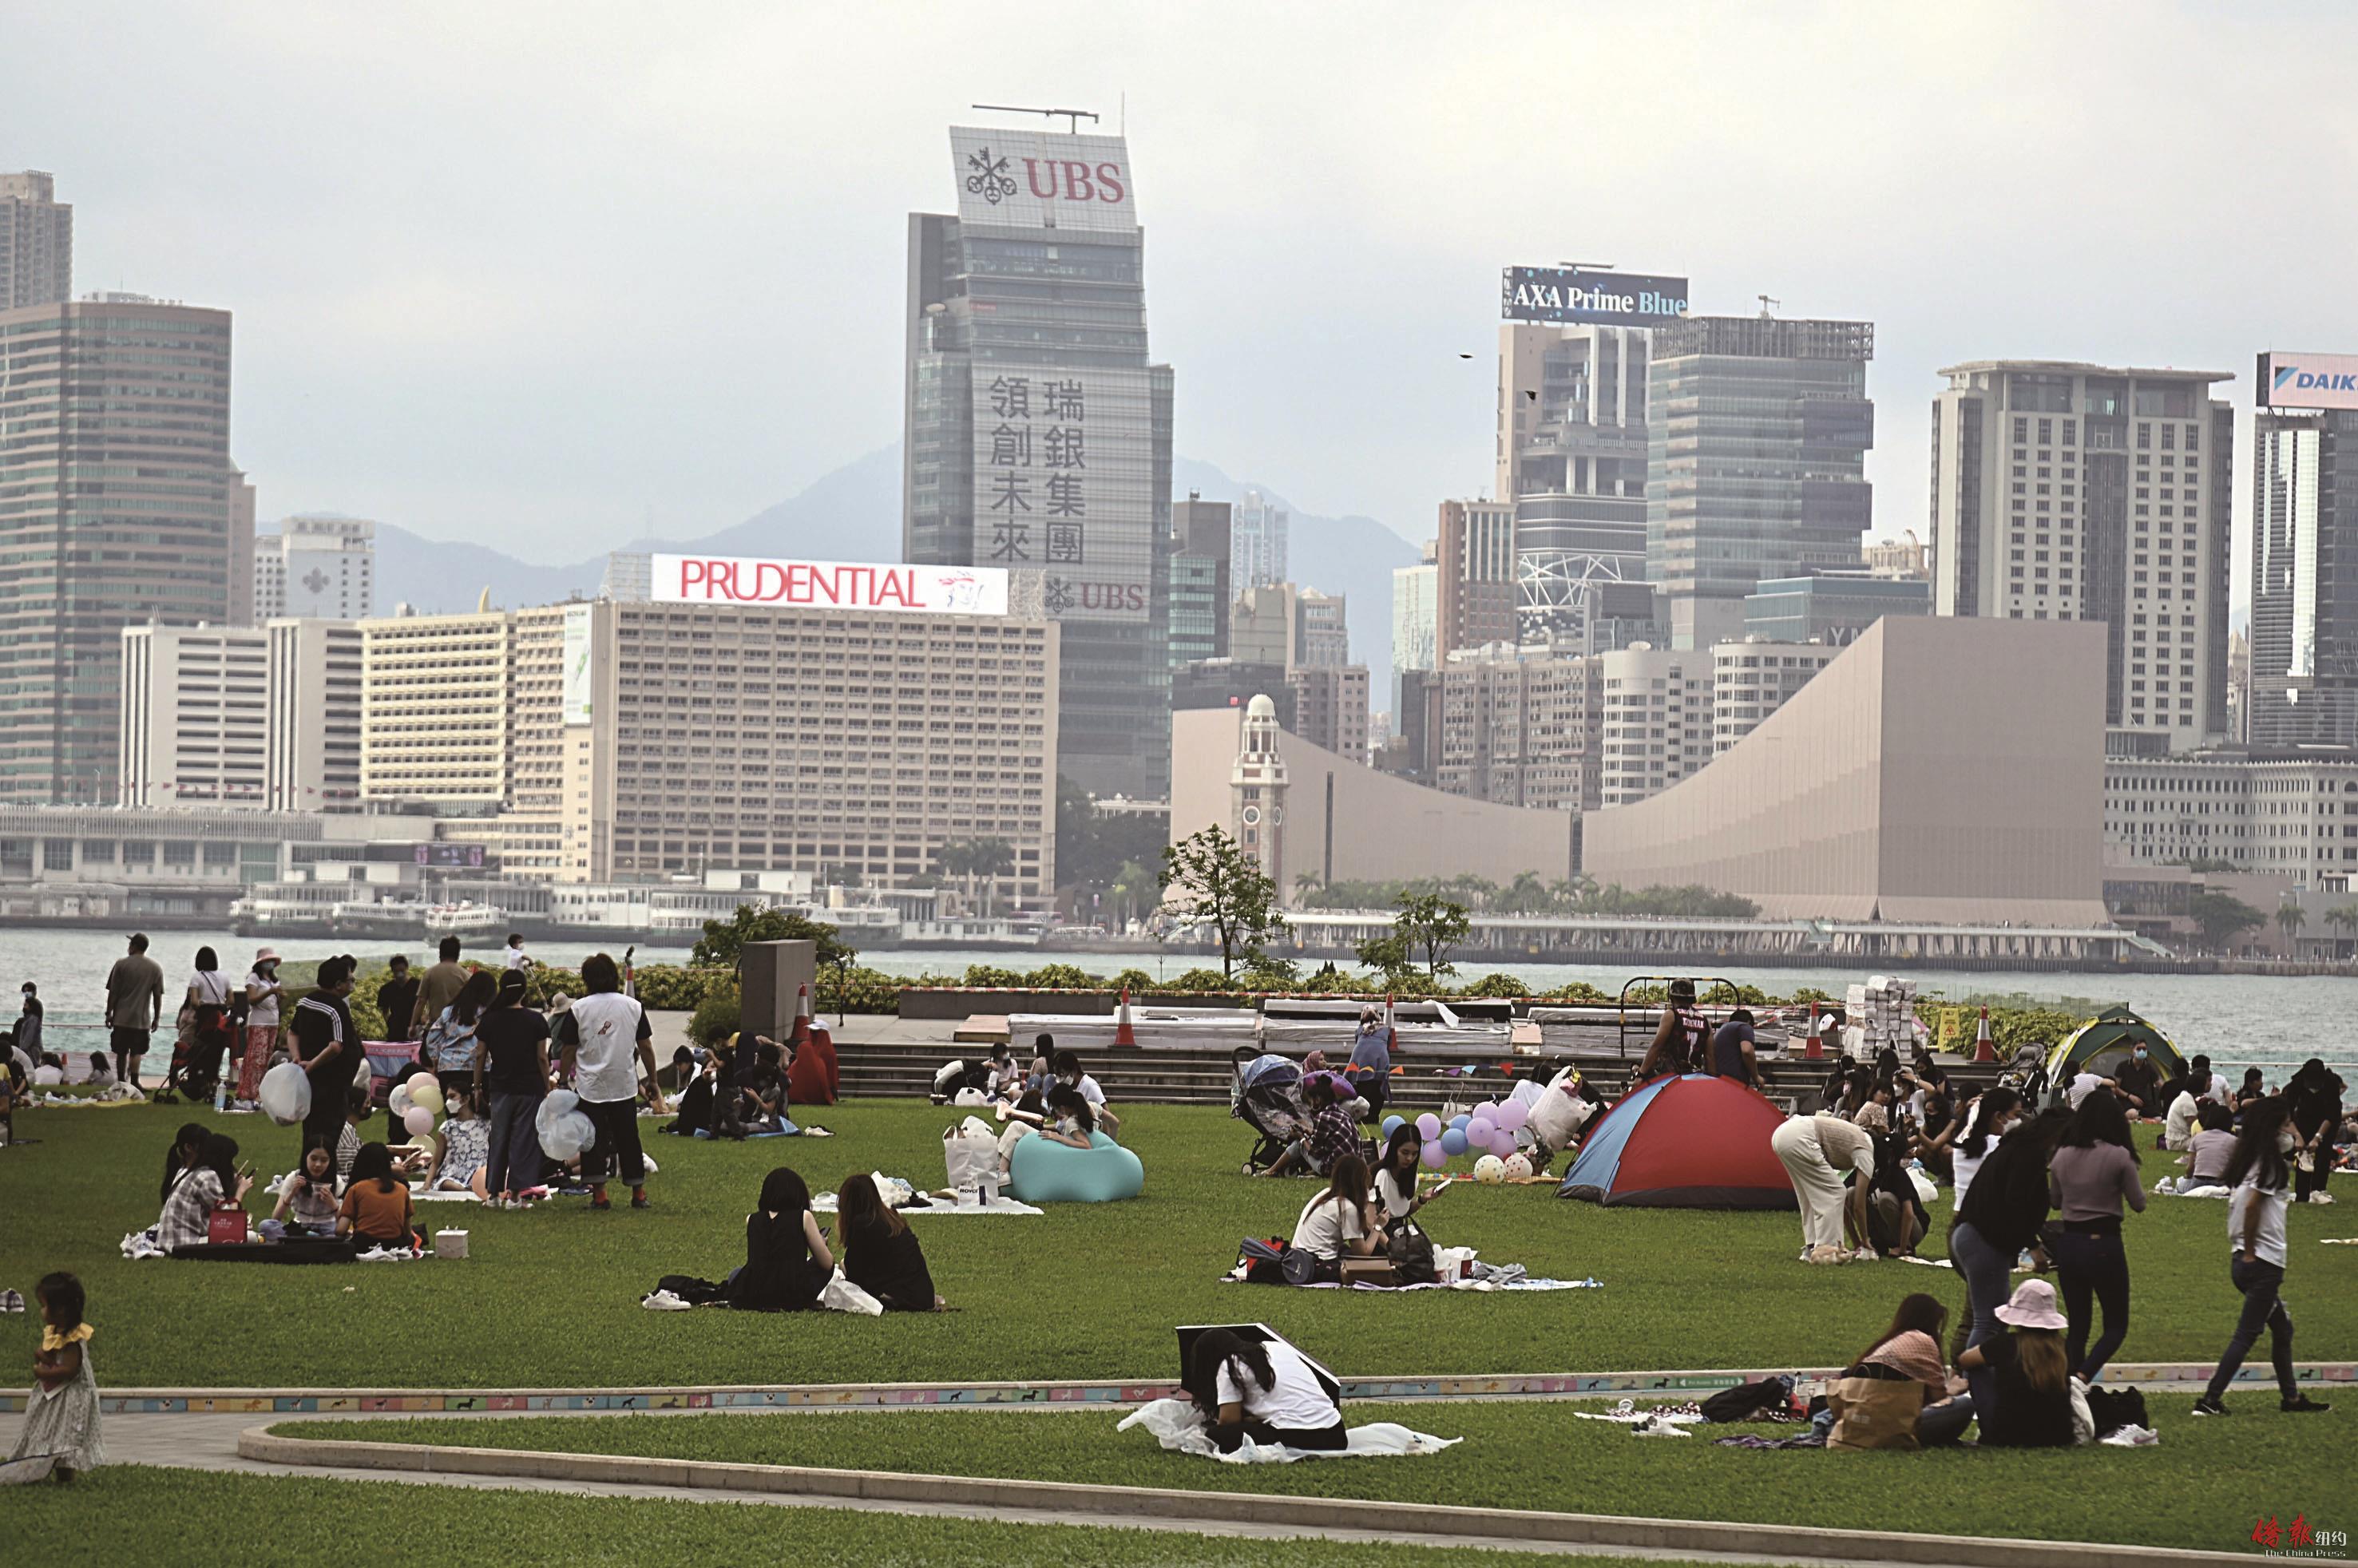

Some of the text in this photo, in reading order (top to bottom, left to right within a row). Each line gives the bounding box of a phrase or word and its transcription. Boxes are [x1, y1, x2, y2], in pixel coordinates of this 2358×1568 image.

[1022, 158, 1124, 204] UBS
[1514, 283, 1687, 318] AXA Prime Blue
[2297, 372, 2358, 390] DAIK
[990, 375, 1032, 562] 領創未來
[1043, 378, 1085, 565] 瑞銀集團
[681, 560, 926, 608] PRUDENTIAL
[1080, 582, 1144, 611] UBS
[2120, 834, 2209, 844] PENINSULA
